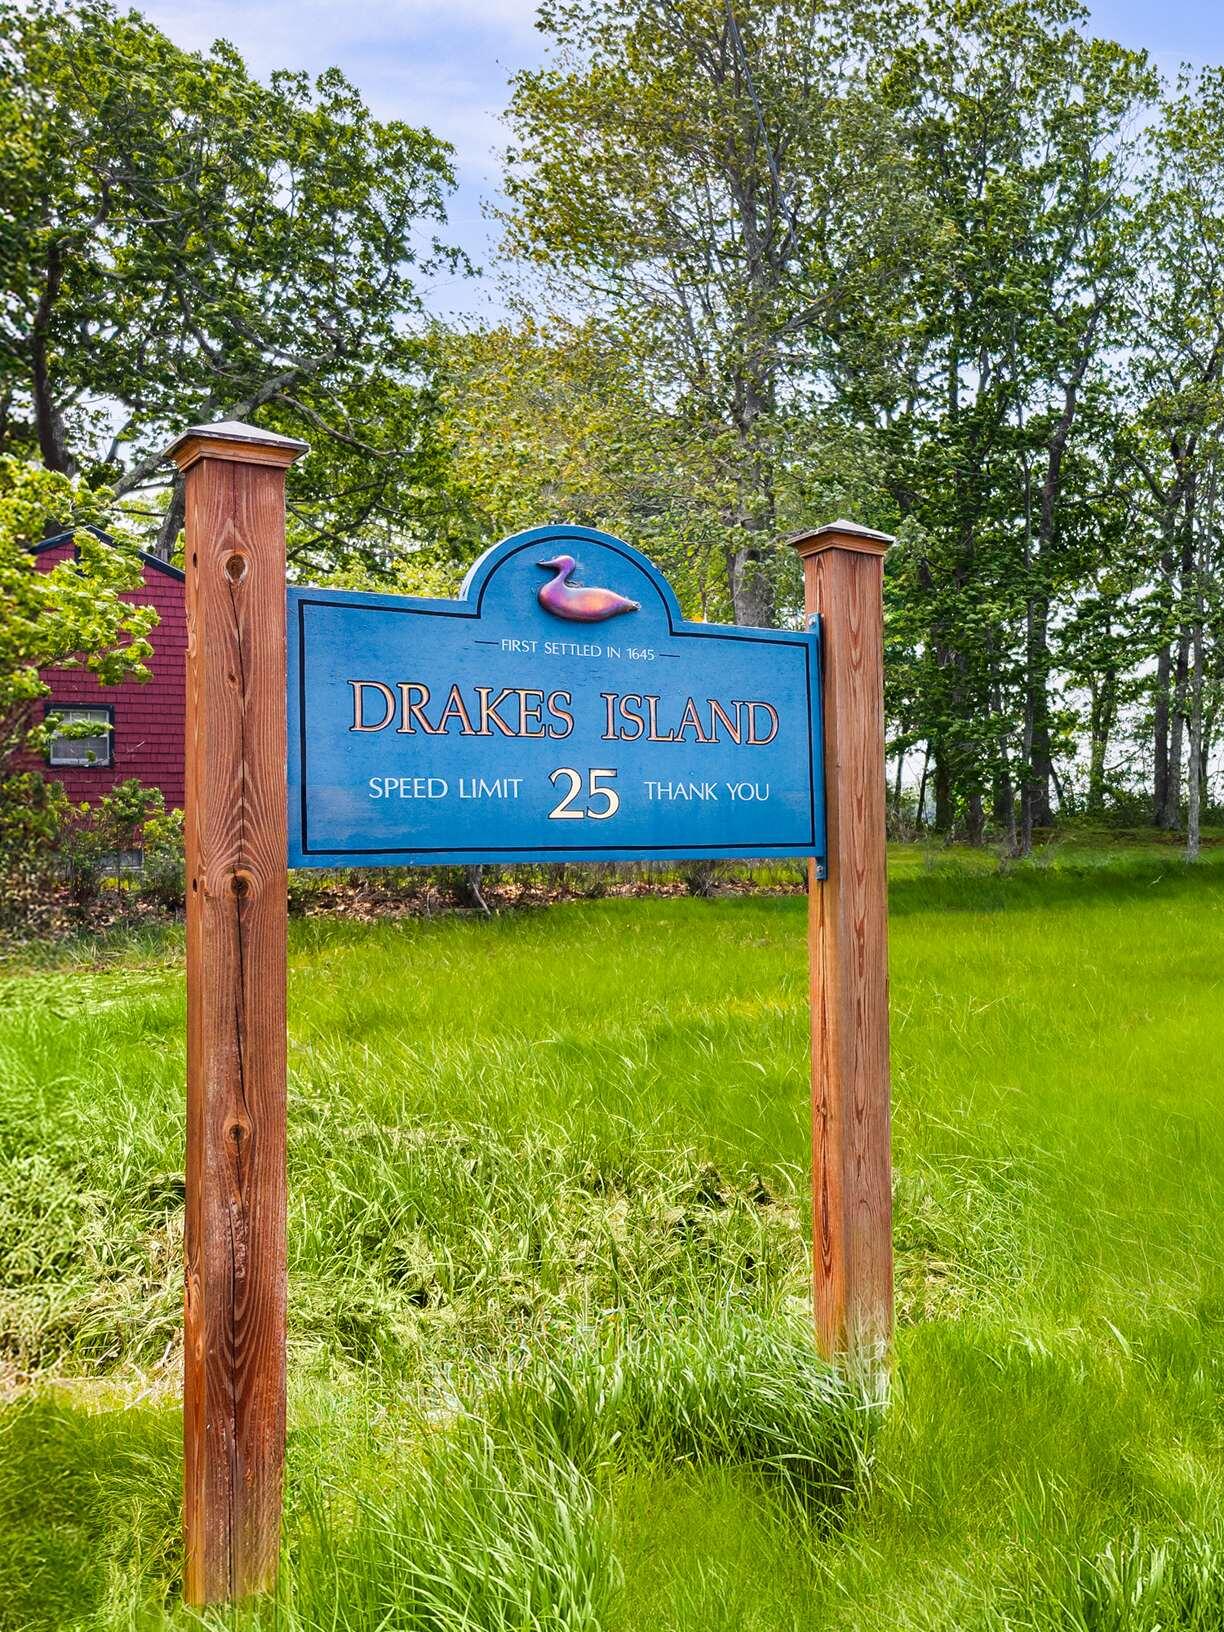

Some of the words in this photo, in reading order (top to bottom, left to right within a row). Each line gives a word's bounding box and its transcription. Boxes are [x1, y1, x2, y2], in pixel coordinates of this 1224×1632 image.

[502, 639, 537, 653] FIRST
[544, 642, 602, 657] SETTLED
[607, 647, 621, 659] IN
[627, 648, 655, 661] 1645
[348, 680, 573, 740] DRAKES
[600, 693, 779, 745] ISLAND
[369, 778, 449, 799] SPEED
[460, 778, 523, 799] LIMIT
[547, 767, 620, 820] 25
[644, 782, 718, 801] THANK
[727, 782, 769, 801] YOU
